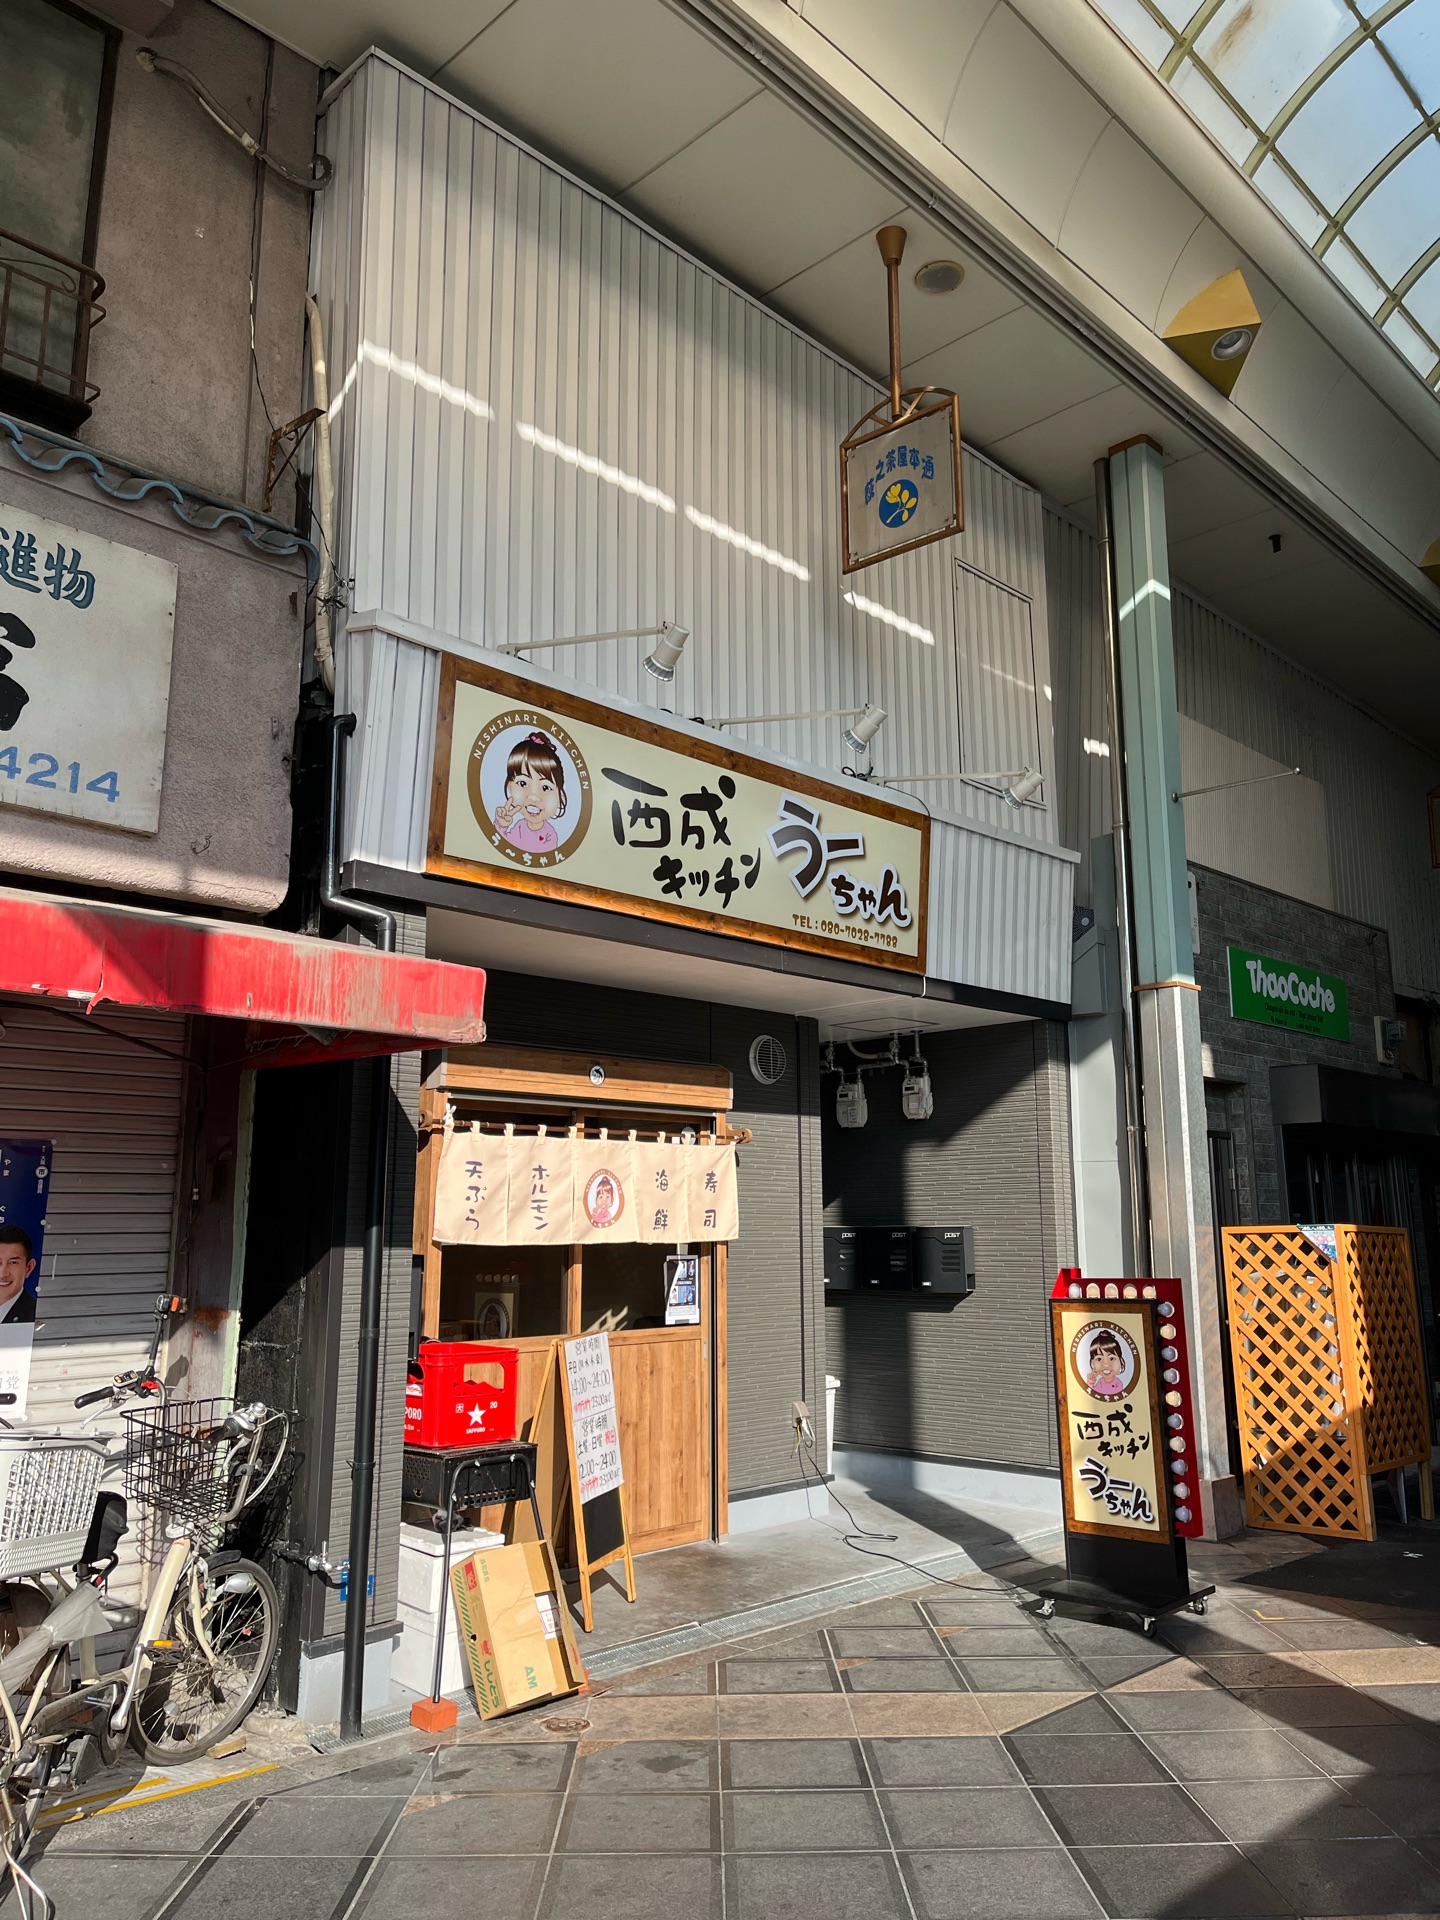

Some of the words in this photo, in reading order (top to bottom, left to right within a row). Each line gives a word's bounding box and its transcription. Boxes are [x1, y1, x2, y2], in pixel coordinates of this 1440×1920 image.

[473, 714, 538, 760] NISHINARI
[550, 724, 590, 790] KITCHEN
[600, 766, 737, 850] 西成
[653, 847, 761, 909] キッチン
[464, 1160, 486, 1231] 天ぷら
[530, 1164, 550, 1231] ホルモン
[652, 1169, 669, 1232] 海鮮
[703, 1170, 718, 1230] 寿司
[1071, 1321, 1103, 1354] NISHINARI
[1109, 1323, 1138, 1356] KITCHEN
[465, 1426, 486, 1435] SAPPORO
[489, 1401, 498, 1409] 20
[1071, 1403, 1134, 1441] 西成
[1097, 1431, 1151, 1460] キッチン
[524, 1665, 539, 1690] AM
